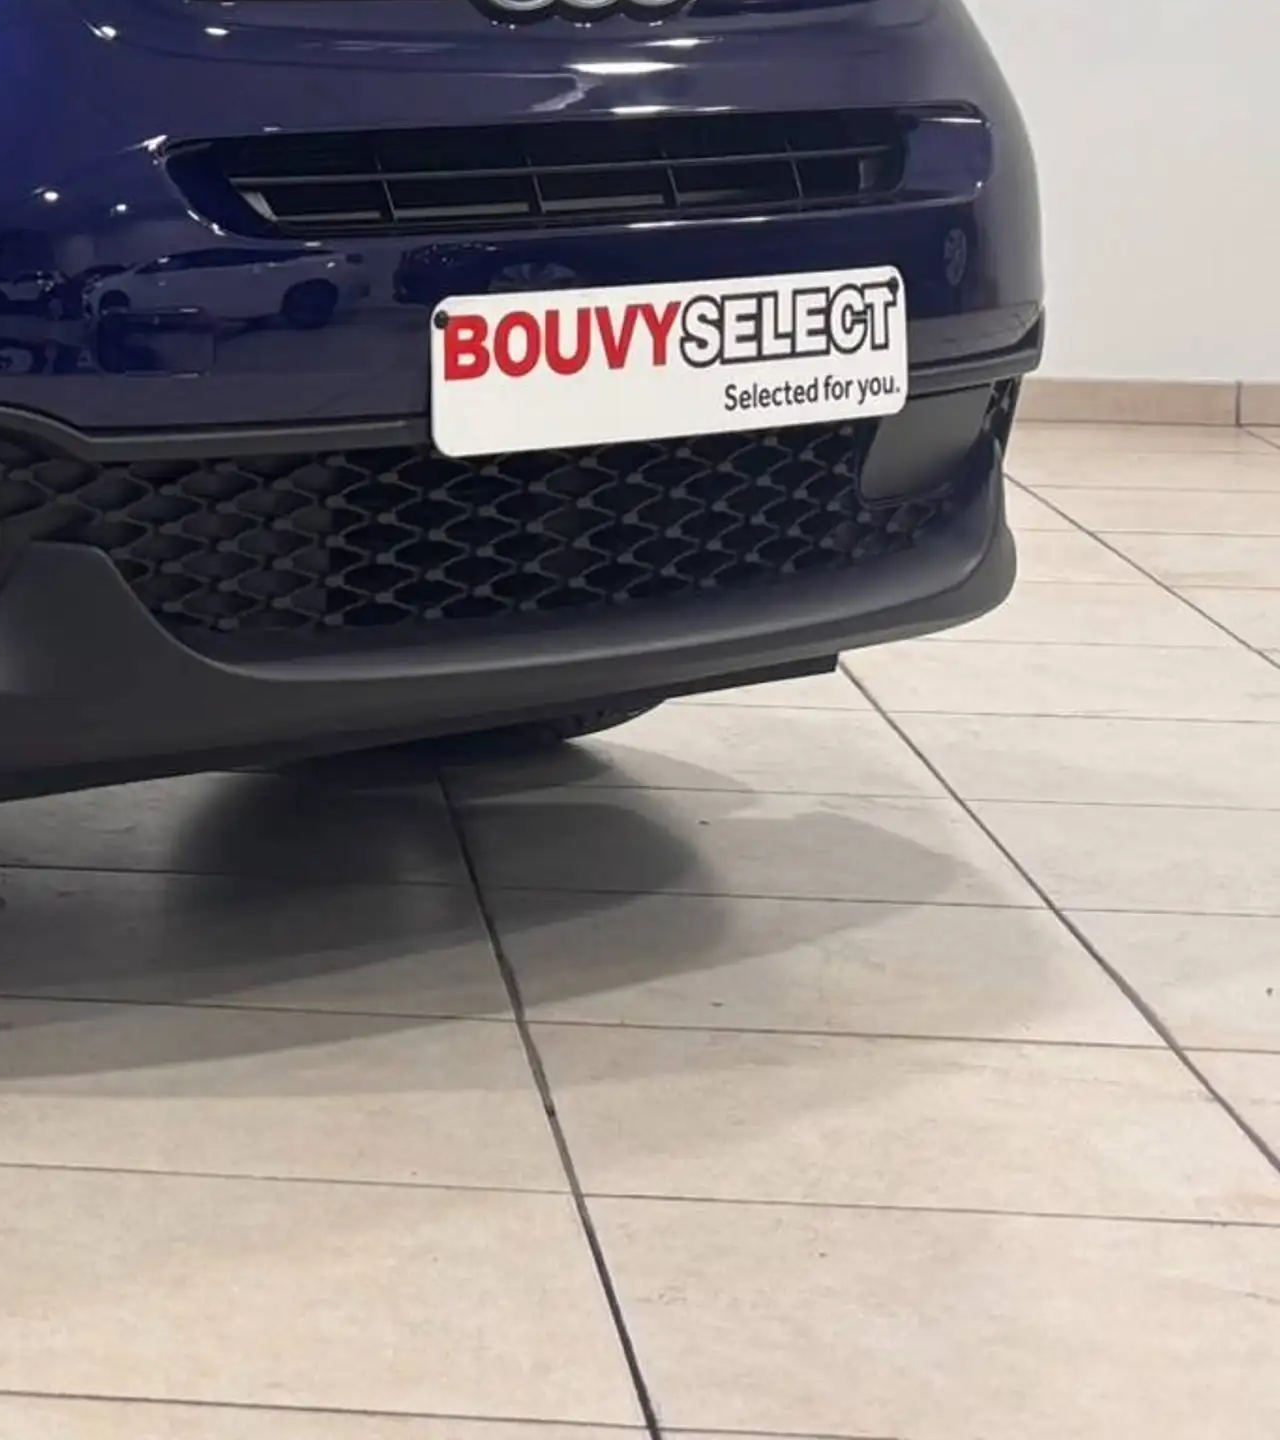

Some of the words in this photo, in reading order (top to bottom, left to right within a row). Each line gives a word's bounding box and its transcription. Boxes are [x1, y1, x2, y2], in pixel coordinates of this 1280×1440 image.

[724, 377, 819, 411] Selected
[823, 374, 853, 402] for
[857, 375, 901, 406] you.
